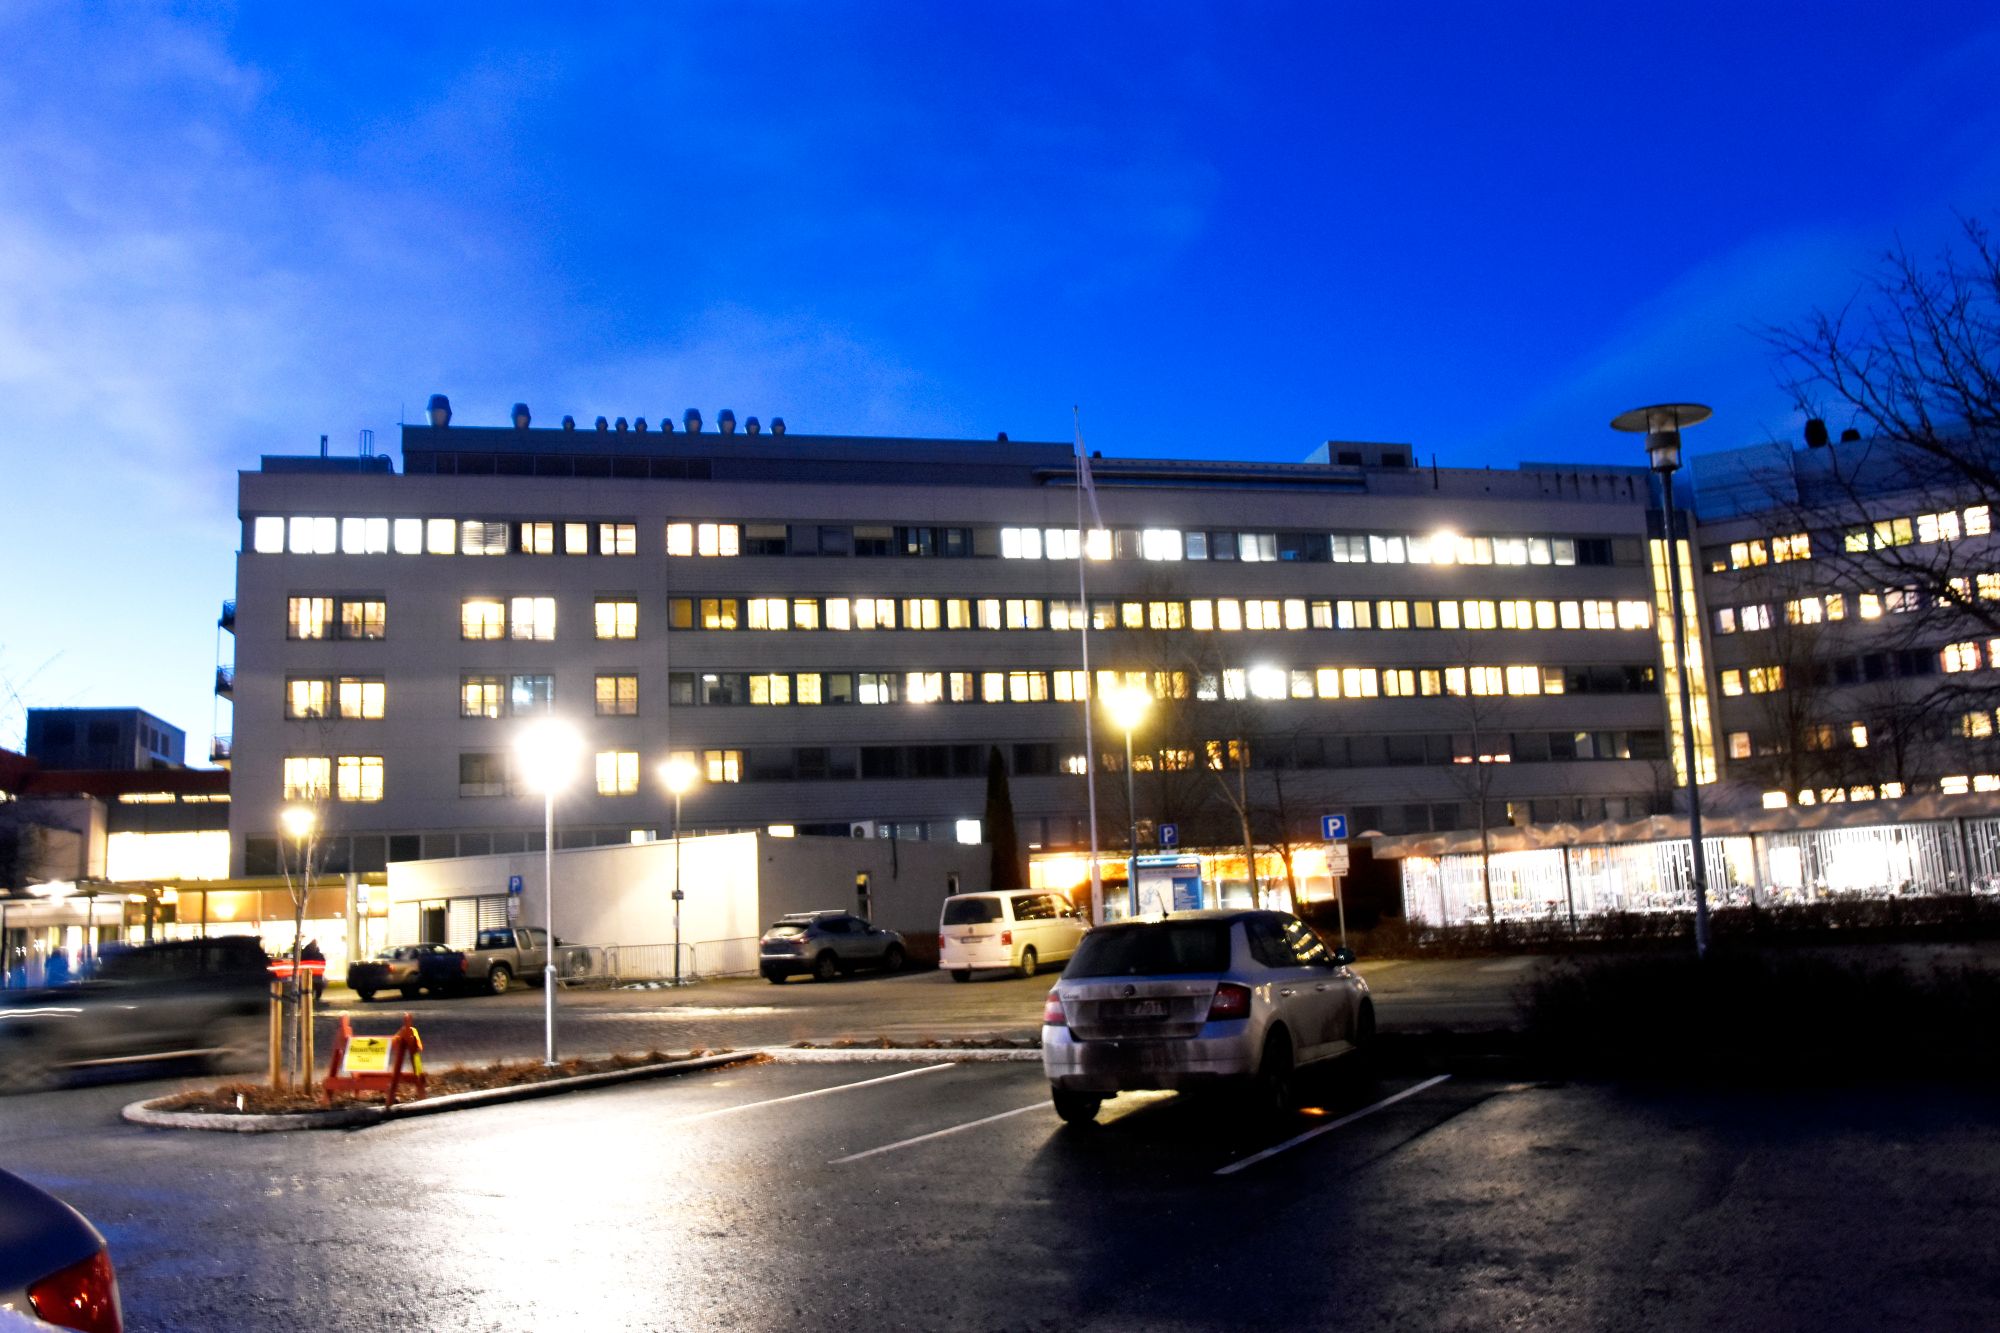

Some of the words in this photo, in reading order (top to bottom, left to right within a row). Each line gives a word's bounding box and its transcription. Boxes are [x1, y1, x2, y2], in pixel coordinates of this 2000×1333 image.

[1163, 827, 1174, 843] P
[1328, 818, 1341, 836] P
[511, 877, 521, 892] P
